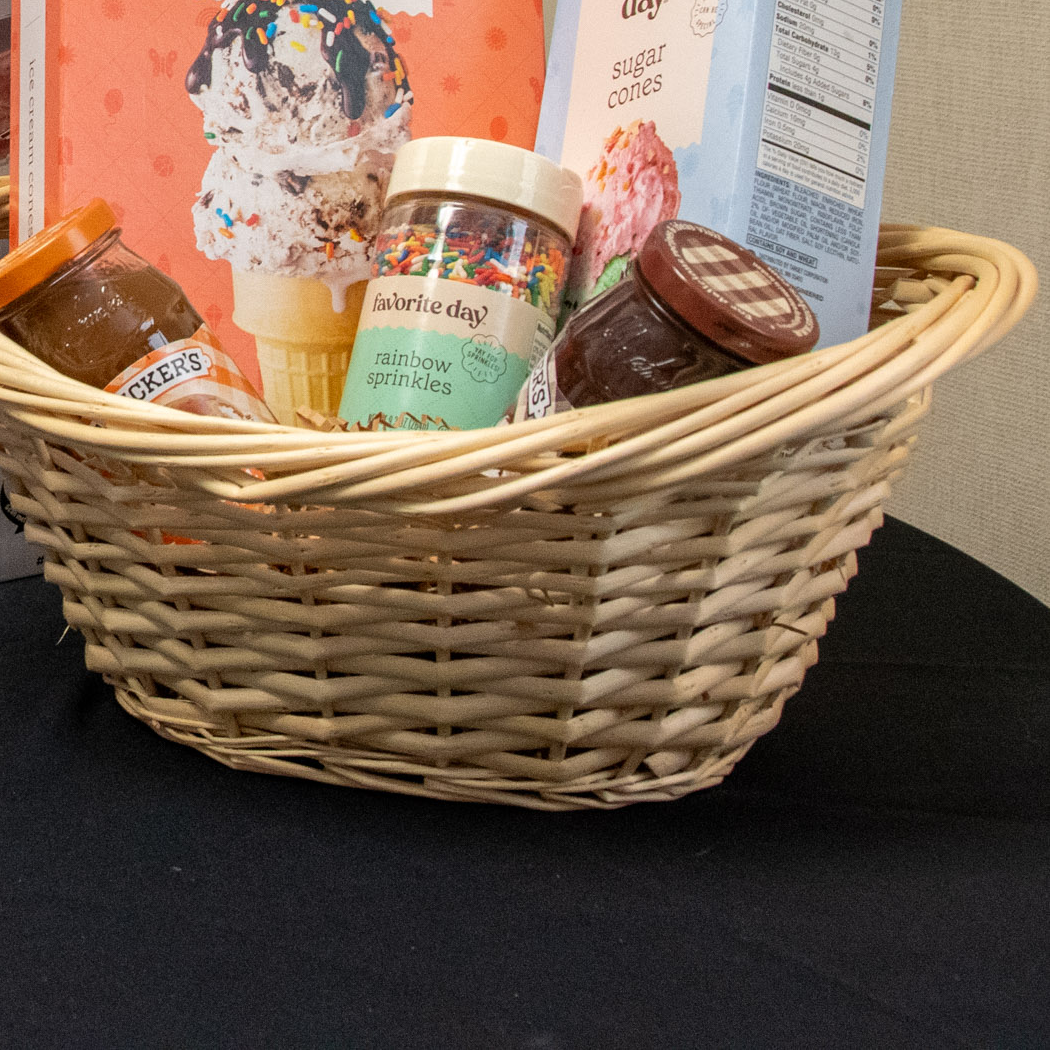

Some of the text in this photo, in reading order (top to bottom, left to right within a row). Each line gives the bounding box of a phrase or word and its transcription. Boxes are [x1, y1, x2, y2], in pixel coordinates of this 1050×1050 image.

[775, 12, 797, 27] Sodium
[777, 0, 810, 20] Cholesterol
[774, 24, 828, 53] Total Carbohydrate
[777, 38, 797, 52] Dietary
[28, 58, 36, 90] ice
[612, 43, 667, 80] sugar
[607, 74, 663, 109] cones
[769, 73, 790, 87] Protein
[762, 128, 792, 146] Potassium
[372, 292, 489, 329] favorite day
[374, 350, 453, 374] rainbow
[366, 370, 452, 396] sprinkles
